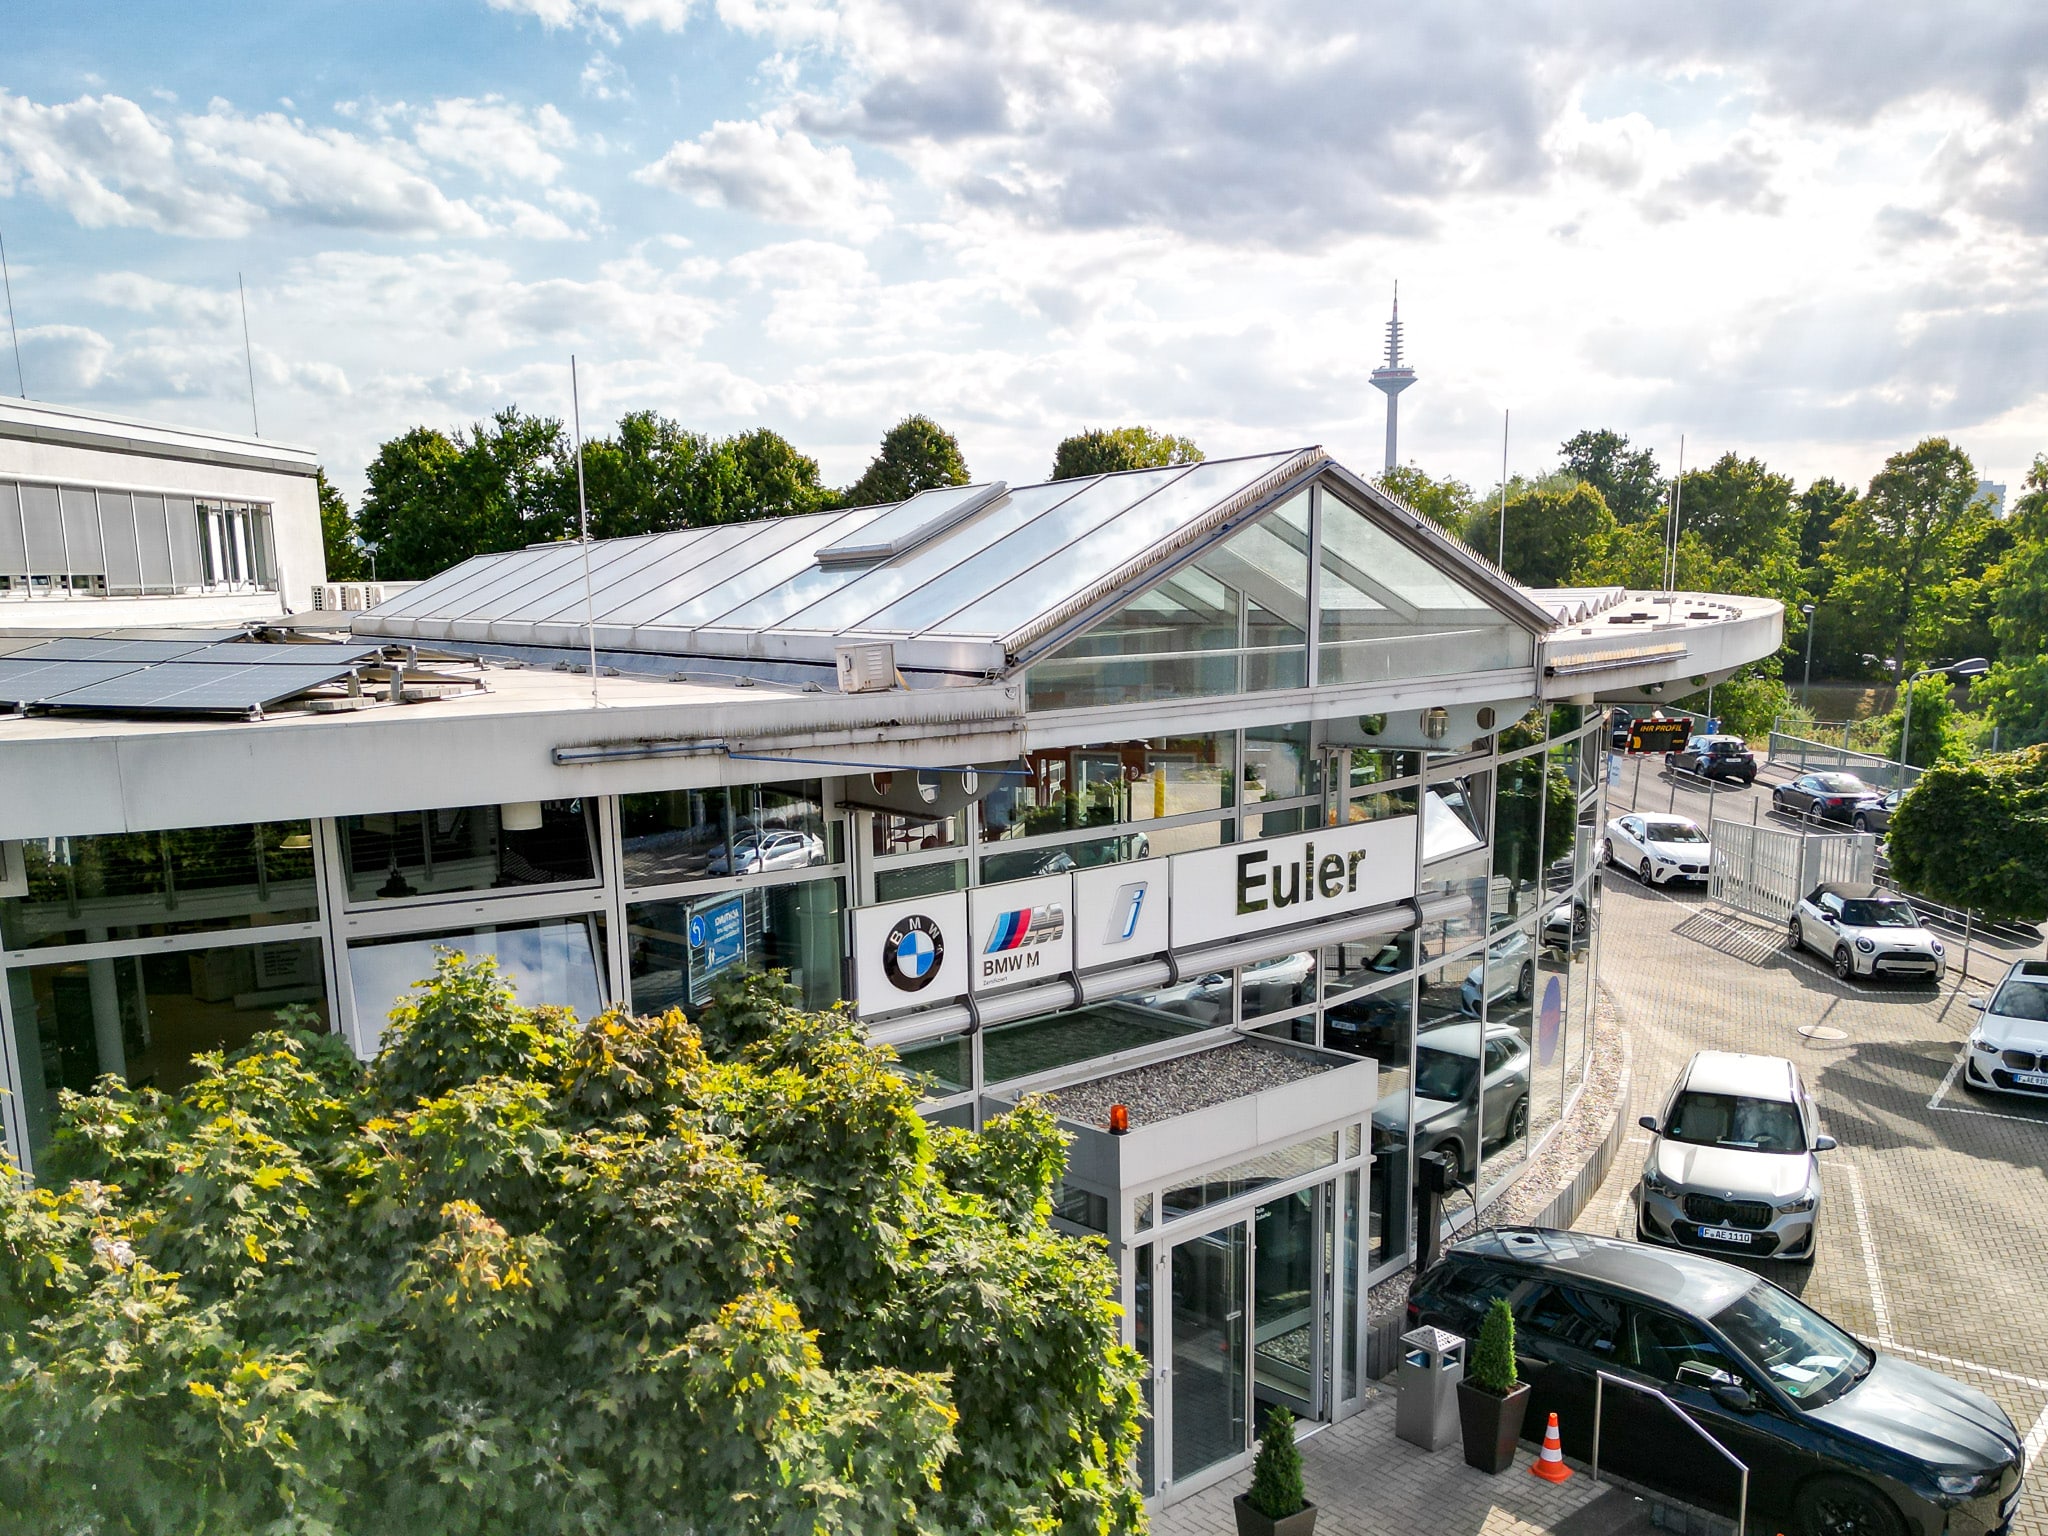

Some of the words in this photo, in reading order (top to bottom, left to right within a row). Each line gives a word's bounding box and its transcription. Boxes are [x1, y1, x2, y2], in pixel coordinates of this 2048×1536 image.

[1655, 724, 1683, 732] PROFIL
[1236, 842, 1366, 915] Euler
[890, 916, 940, 946] BMW
[983, 954, 1023, 976] BMW
[1026, 951, 1040, 969] M
[1715, 1231, 1726, 1239] AE
[1728, 1232, 1750, 1242] 1110
